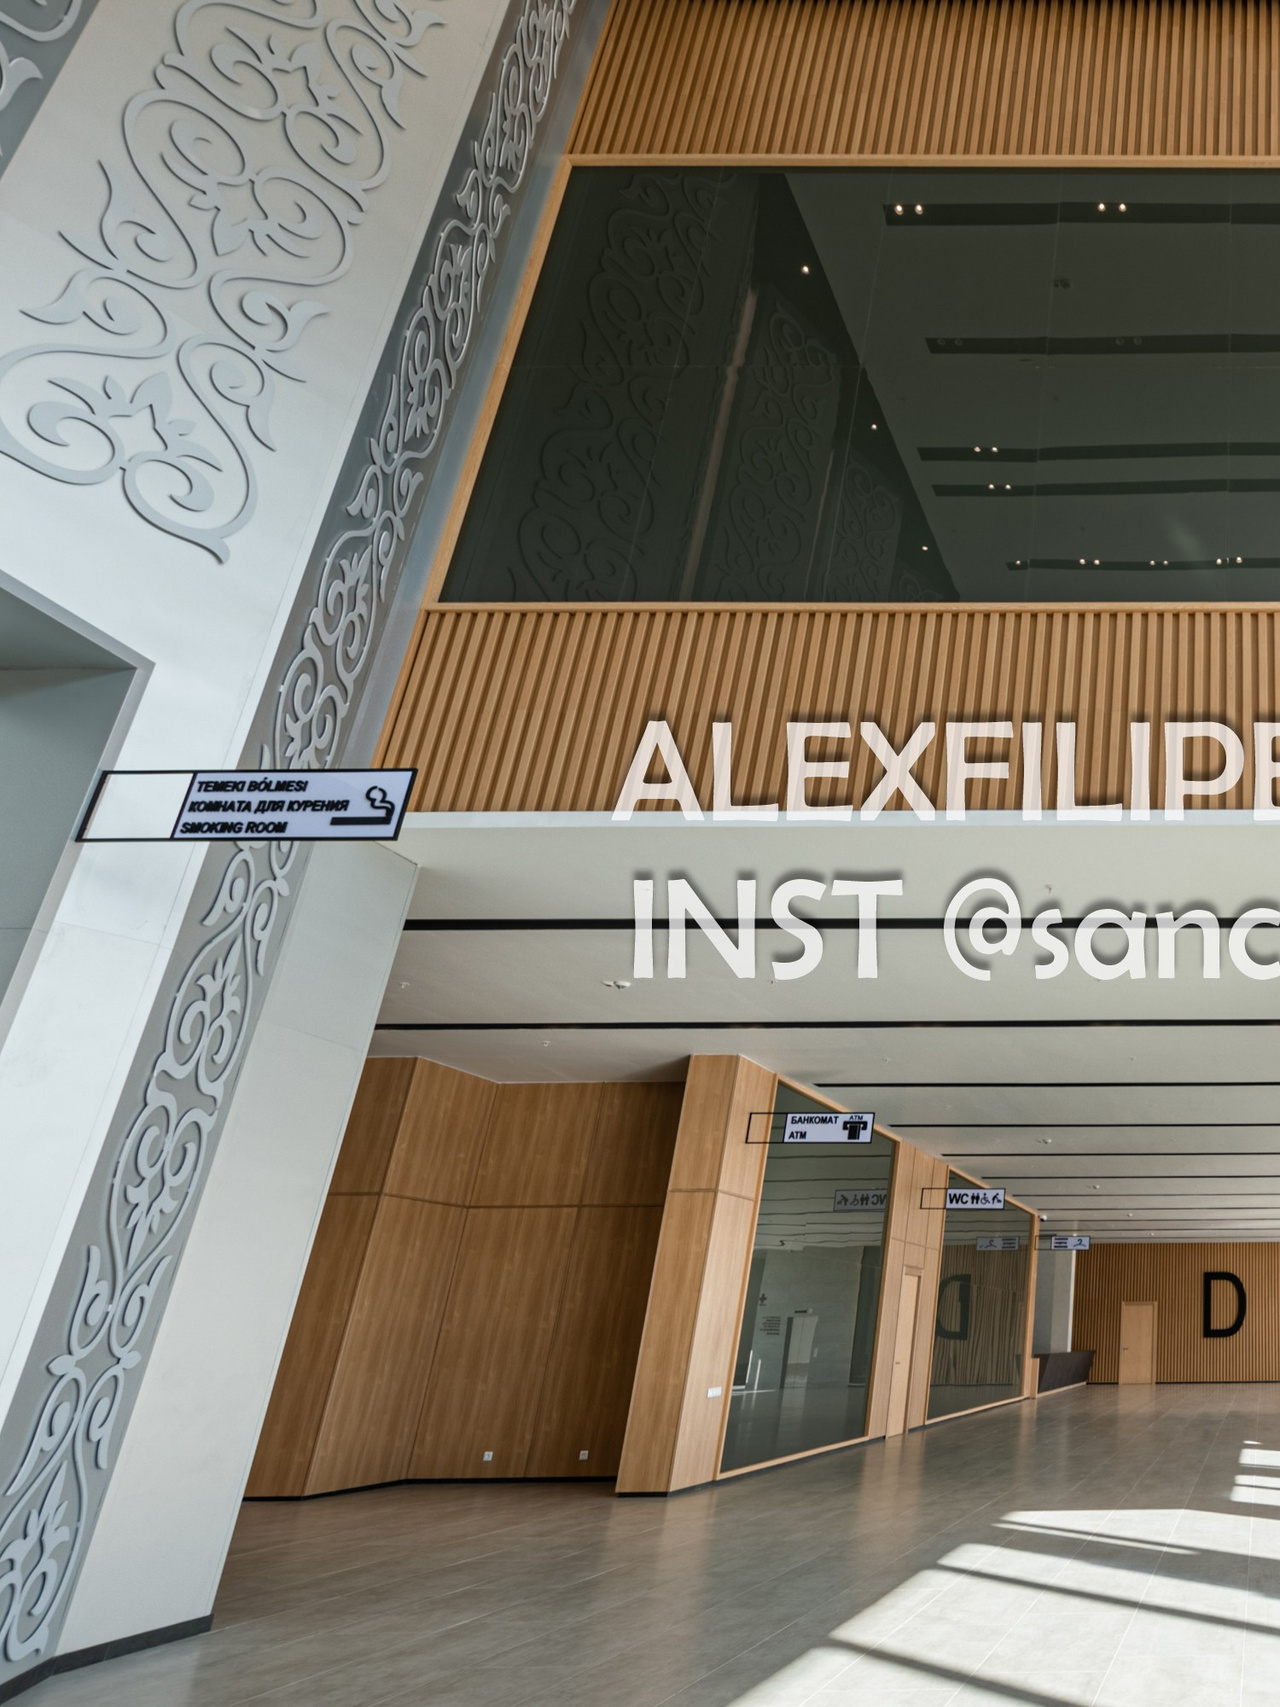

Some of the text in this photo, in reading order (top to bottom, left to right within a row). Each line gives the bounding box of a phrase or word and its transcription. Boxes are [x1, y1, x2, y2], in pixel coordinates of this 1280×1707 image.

[197, 780, 246, 792] TEMEKI
[188, 800, 350, 814] КОМНАТА ДЛЯ КУРЕНИЯ
[180, 822, 289, 834] SMOKING ROOM
[791, 1116, 839, 1124] БАНКОМАТ
[788, 1131, 807, 1140] ATM
[949, 1193, 969, 1204] WC
[1203, 1271, 1247, 1338] D
